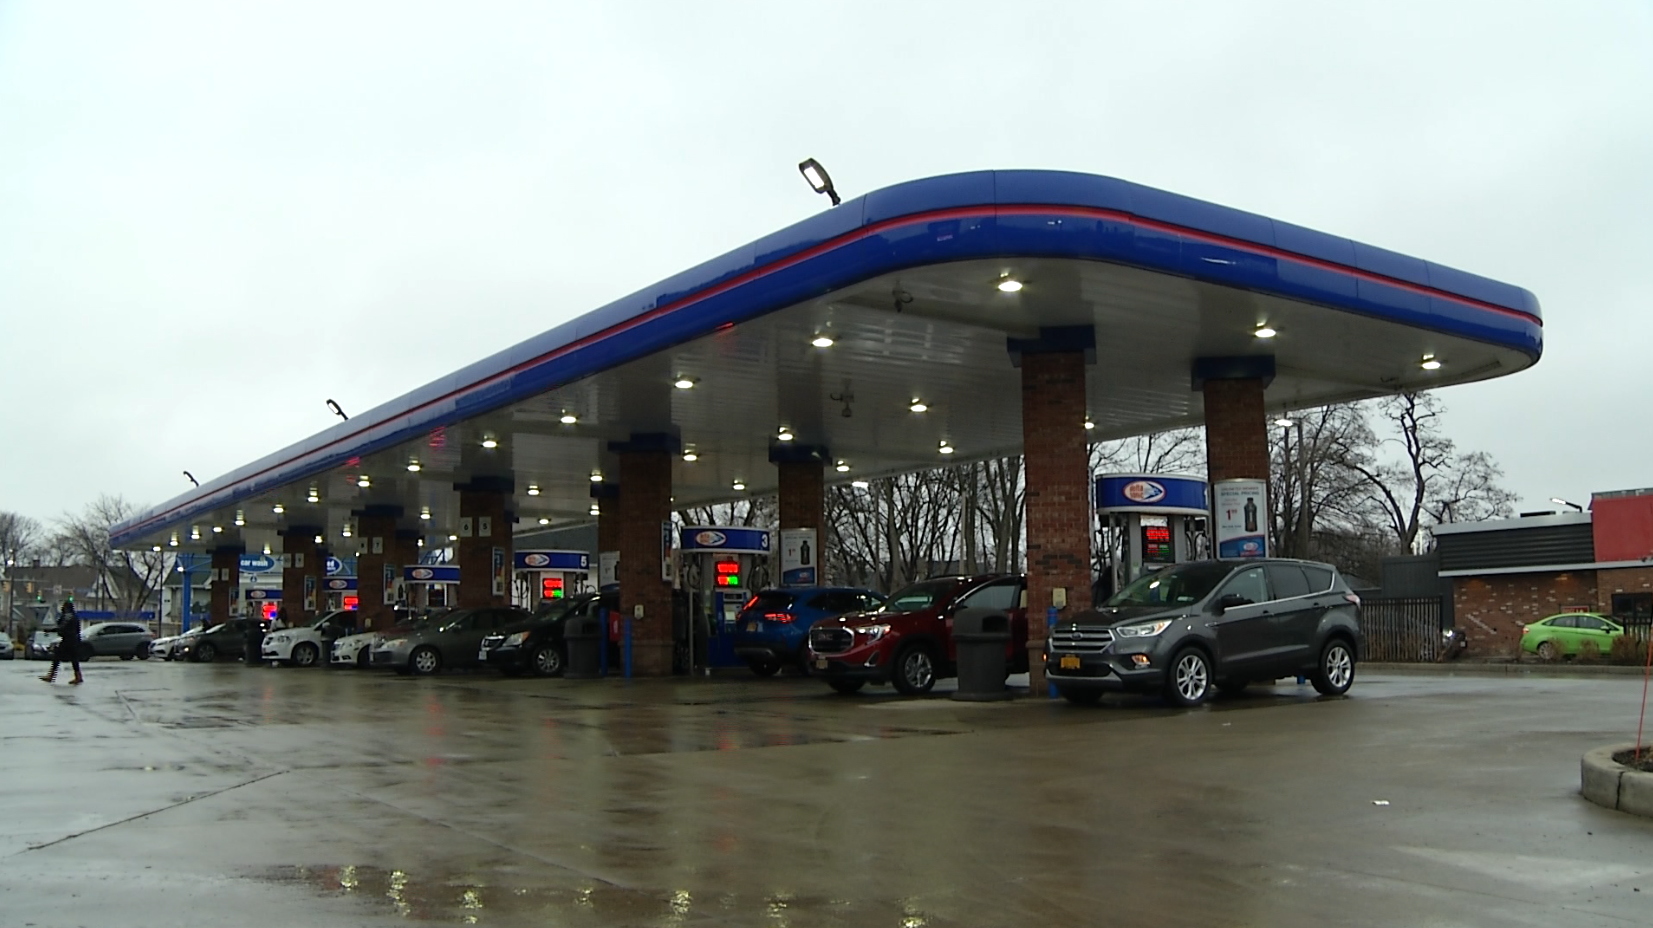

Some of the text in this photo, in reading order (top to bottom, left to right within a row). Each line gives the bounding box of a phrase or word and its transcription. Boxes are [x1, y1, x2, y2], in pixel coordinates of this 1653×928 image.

[761, 533, 768, 548] 3
[252, 559, 269, 567] wash
[580, 555, 587, 567] 5
